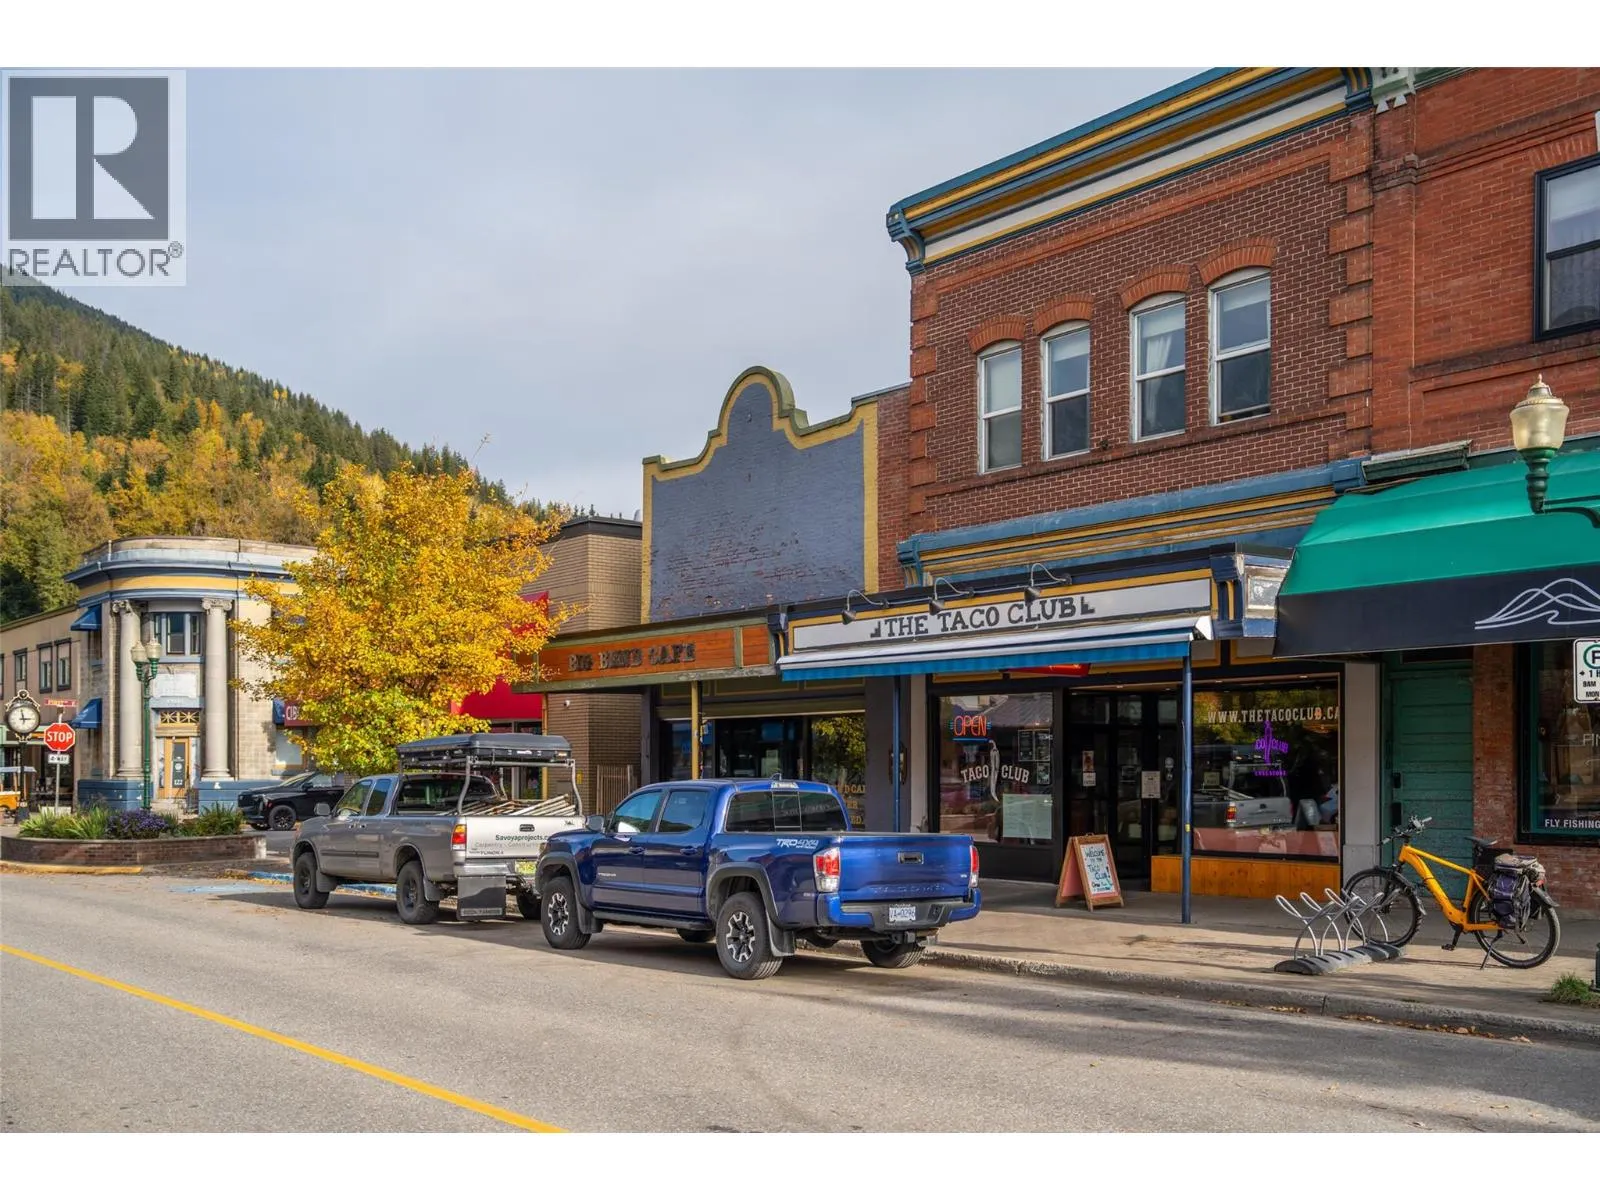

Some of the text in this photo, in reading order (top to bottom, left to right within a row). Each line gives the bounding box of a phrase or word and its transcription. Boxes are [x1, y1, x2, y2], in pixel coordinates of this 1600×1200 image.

[884, 599, 1076, 637] THE TACO CLUB
[953, 715, 987, 736] OPEN
[47, 732, 72, 742] STOP
[961, 765, 1030, 784] TACO CLUB
[1545, 819, 1600, 828] FLY FISHING
